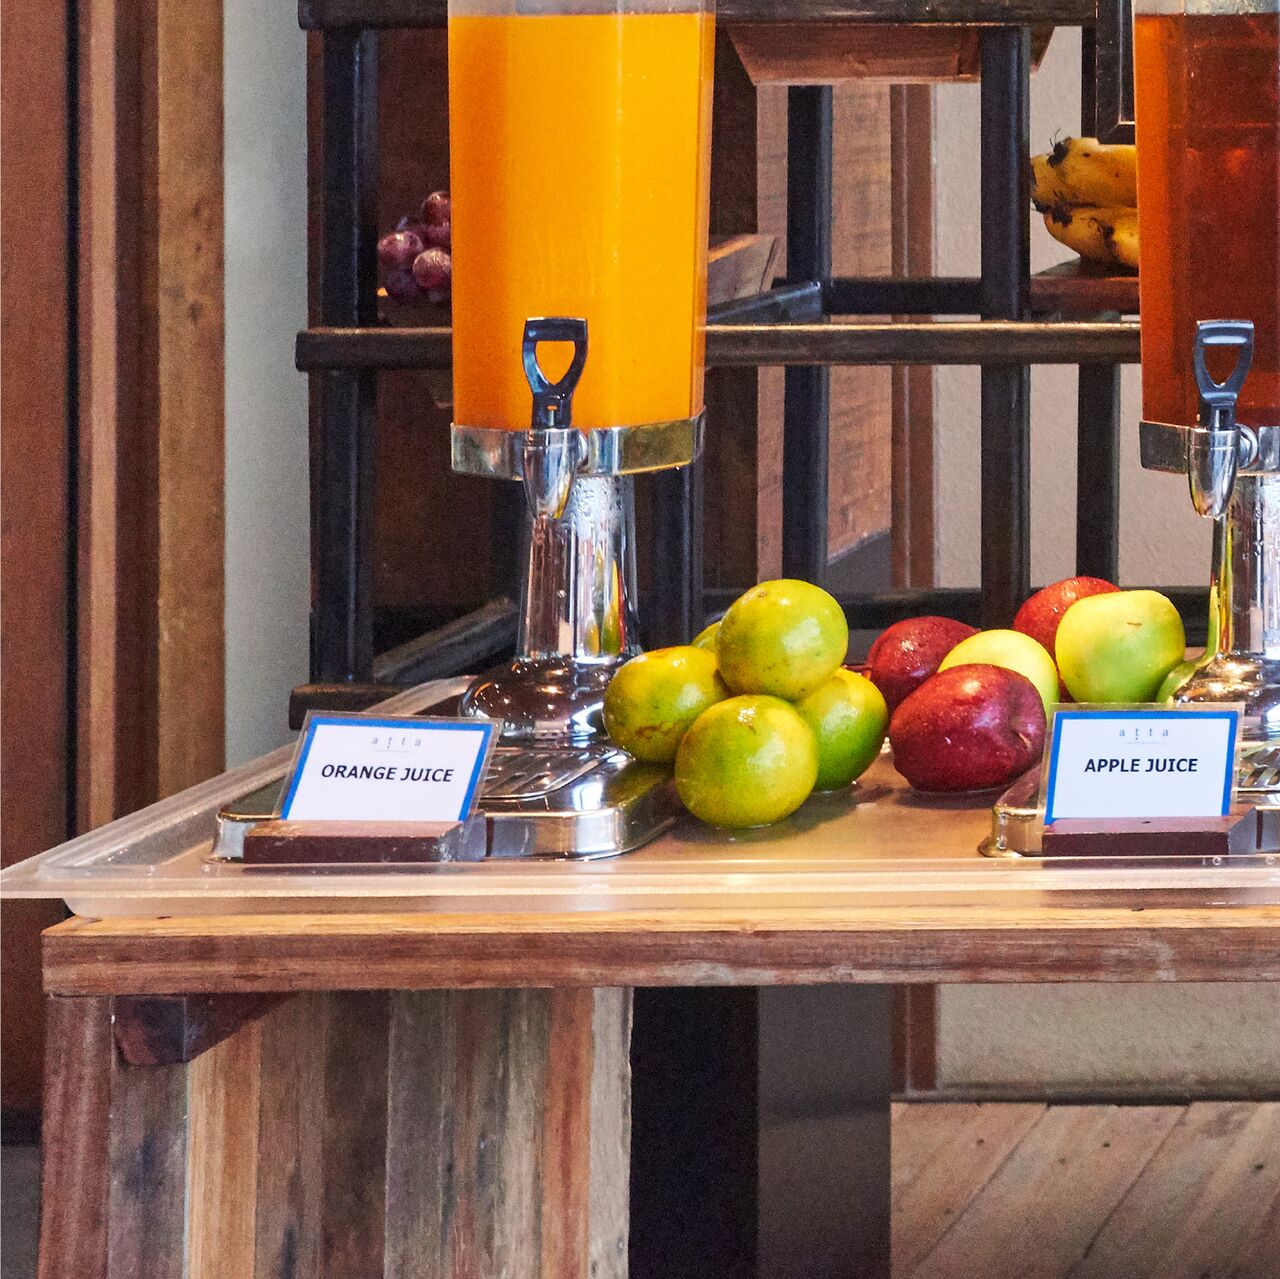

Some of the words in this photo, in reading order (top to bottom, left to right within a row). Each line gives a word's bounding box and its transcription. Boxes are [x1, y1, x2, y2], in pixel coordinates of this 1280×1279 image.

[321, 764, 398, 781] ORANGE
[400, 767, 455, 783] JUICE
[1084, 758, 1141, 773] APPLE
[1145, 758, 1199, 773] JUICE
